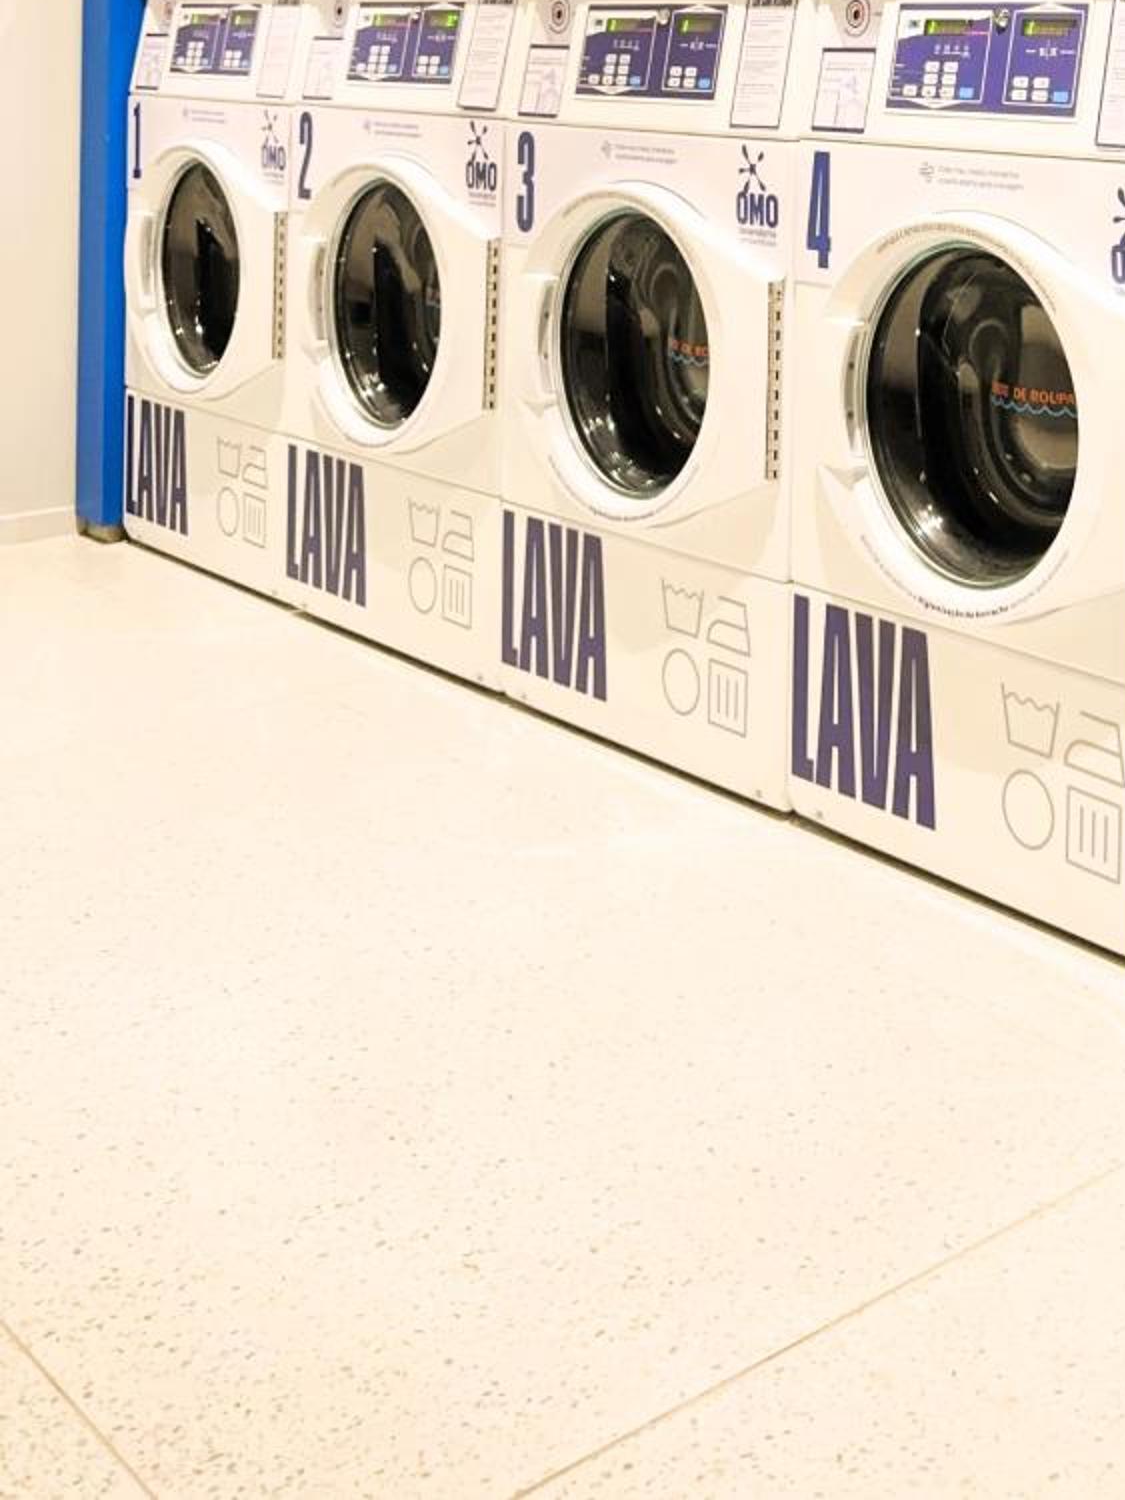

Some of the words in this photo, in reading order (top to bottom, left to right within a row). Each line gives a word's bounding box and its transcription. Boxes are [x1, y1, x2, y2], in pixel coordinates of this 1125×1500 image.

[133, 103, 141, 178] 1
[261, 144, 286, 171] OMO
[298, 112, 311, 199] 2
[465, 162, 497, 191] OMO
[516, 131, 534, 232] 3
[736, 192, 779, 228] OMO
[806, 151, 831, 269] 4
[125, 394, 188, 536] LAVA
[286, 444, 366, 608] LAVA
[501, 510, 607, 702] LAVA
[791, 593, 936, 831] LAVA
